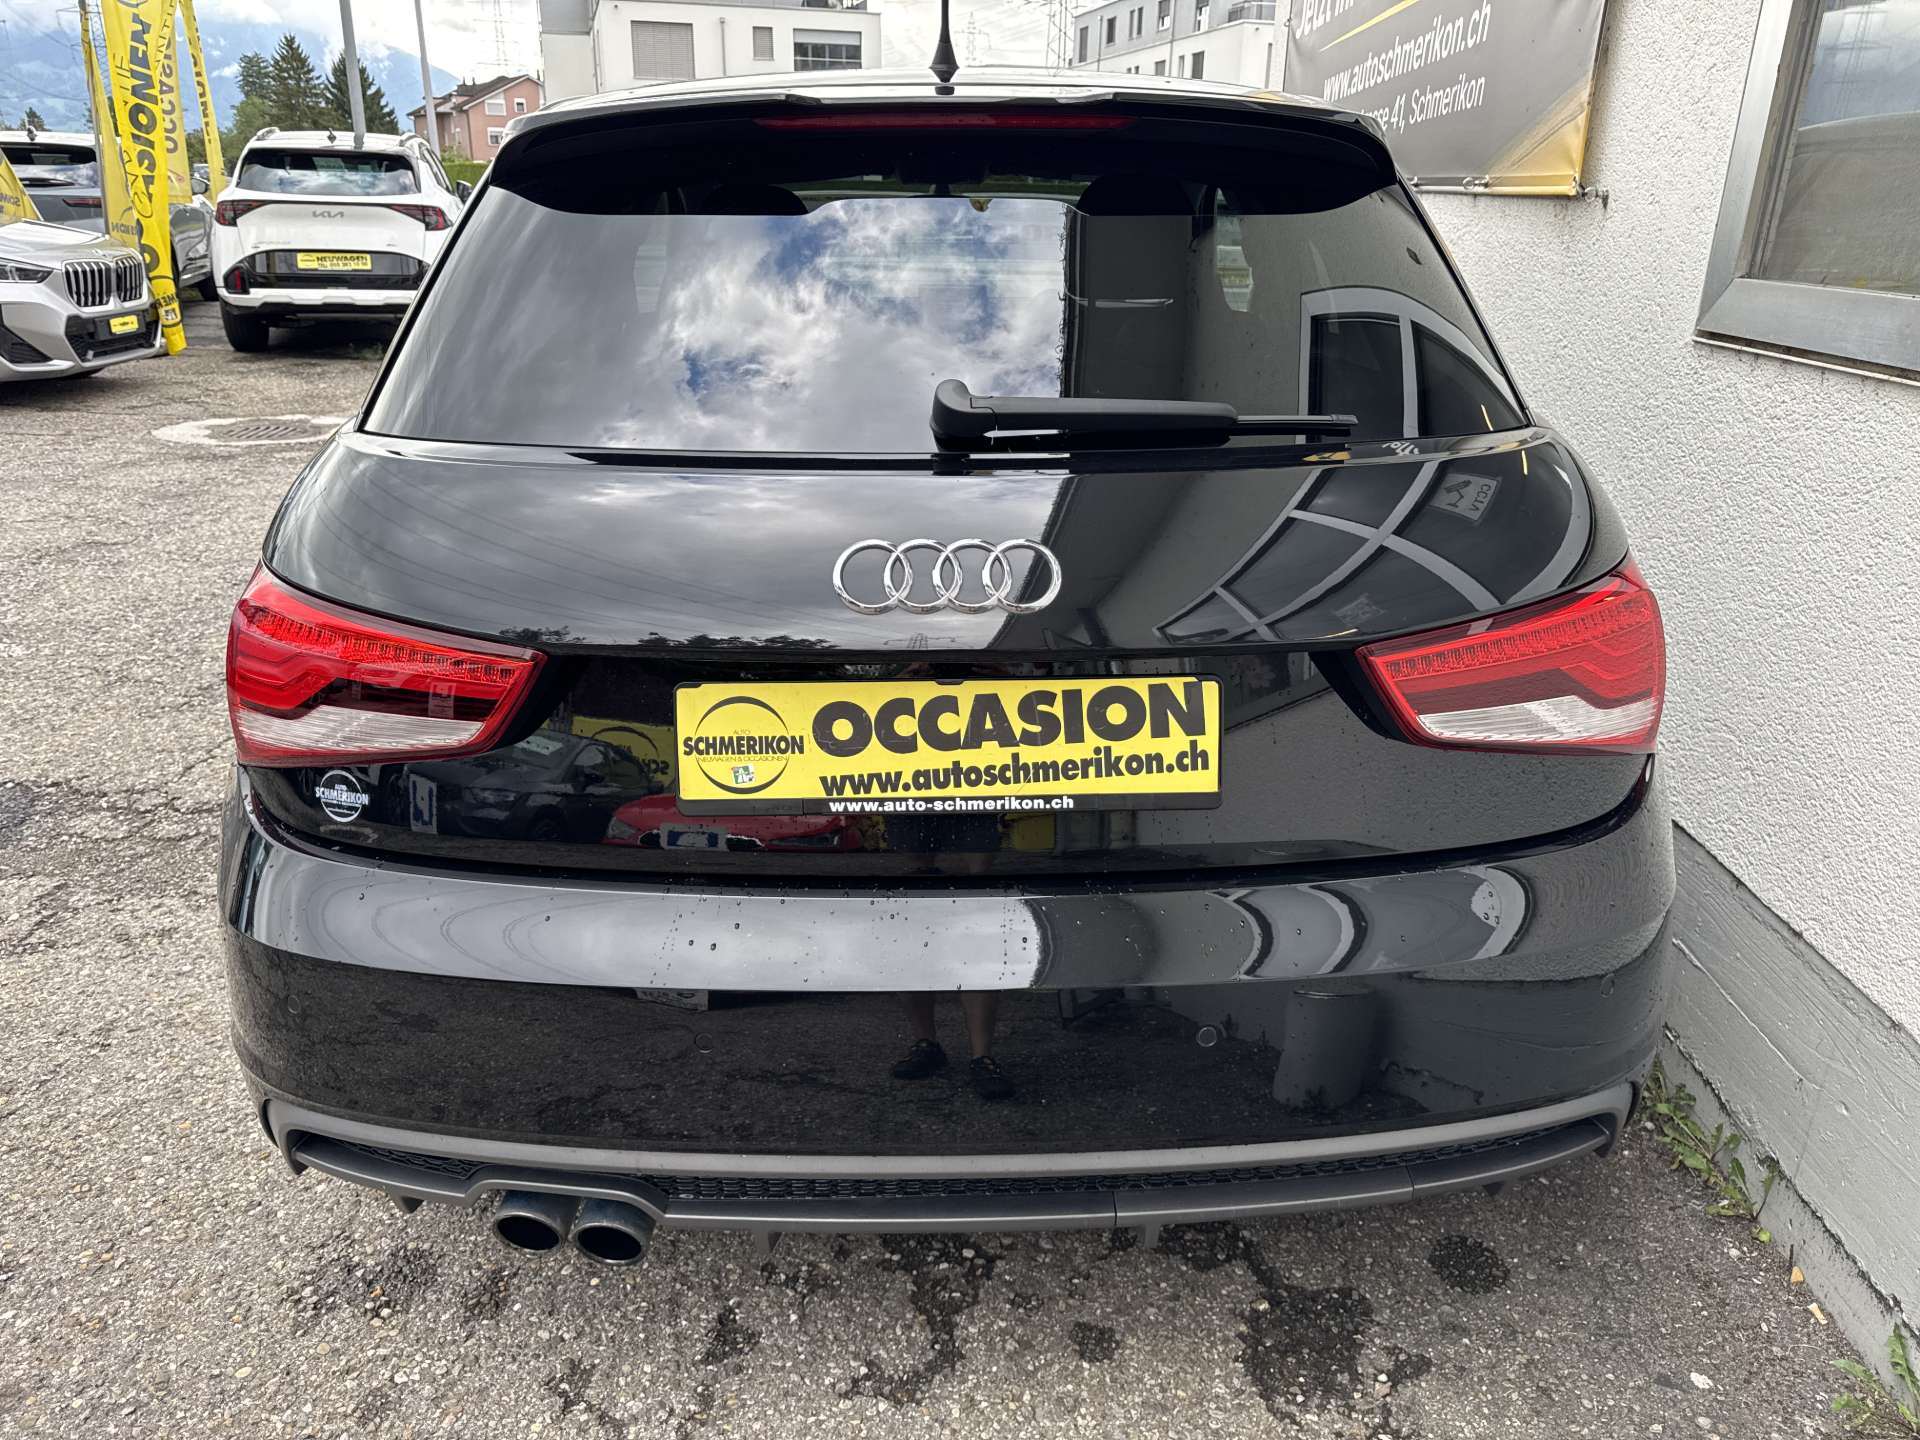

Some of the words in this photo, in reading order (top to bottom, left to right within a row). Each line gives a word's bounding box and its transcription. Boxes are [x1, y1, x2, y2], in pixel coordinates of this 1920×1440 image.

[1323, 0, 1491, 102] www.autoschmerikon.ch
[1409, 72, 1486, 125] Schmerikon
[683, 735, 804, 756] SCHMERIKON
[812, 682, 1206, 757] OCCASION
[819, 740, 1209, 797] www.autoschmerikon.ch
[315, 786, 369, 805] SCHMERIKON
[829, 797, 1074, 811] www.auto-schmerikon.ch
